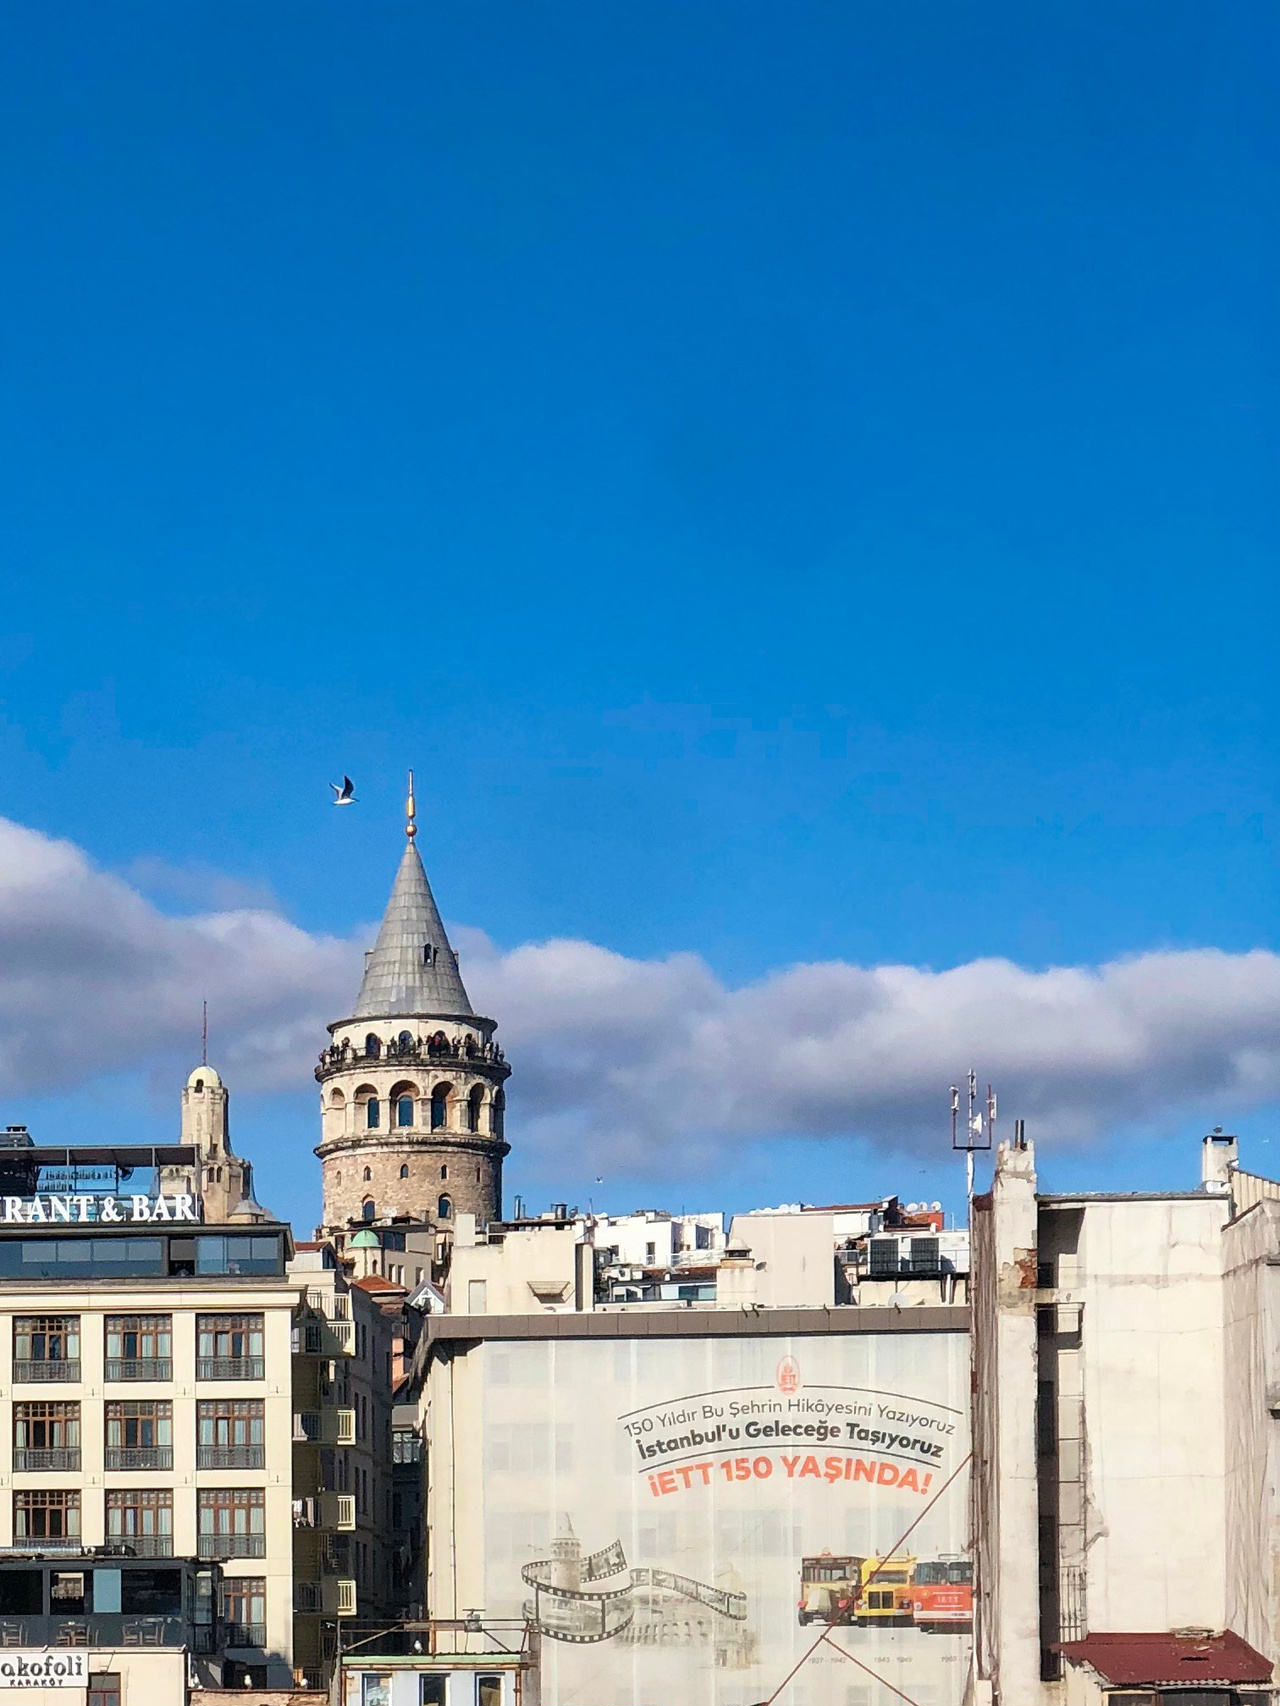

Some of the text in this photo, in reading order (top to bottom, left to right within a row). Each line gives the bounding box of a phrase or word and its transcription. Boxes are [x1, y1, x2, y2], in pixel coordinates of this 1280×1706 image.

[101, 1196, 126, 1222] &
[131, 1194, 199, 1222] BAR
[624, 1419, 654, 1437] 150
[702, 1405, 724, 1419] Bu
[729, 1399, 782, 1418] Şehrin
[788, 1399, 873, 1416] Hikâyesini
[878, 1404, 956, 1435] Yazıyoruz
[745, 1419, 841, 1441] Geleceğe
[846, 1422, 944, 1458] Taşıyoruz
[720, 1456, 773, 1482] 150
[780, 1455, 933, 1495] YAŞINDA!
